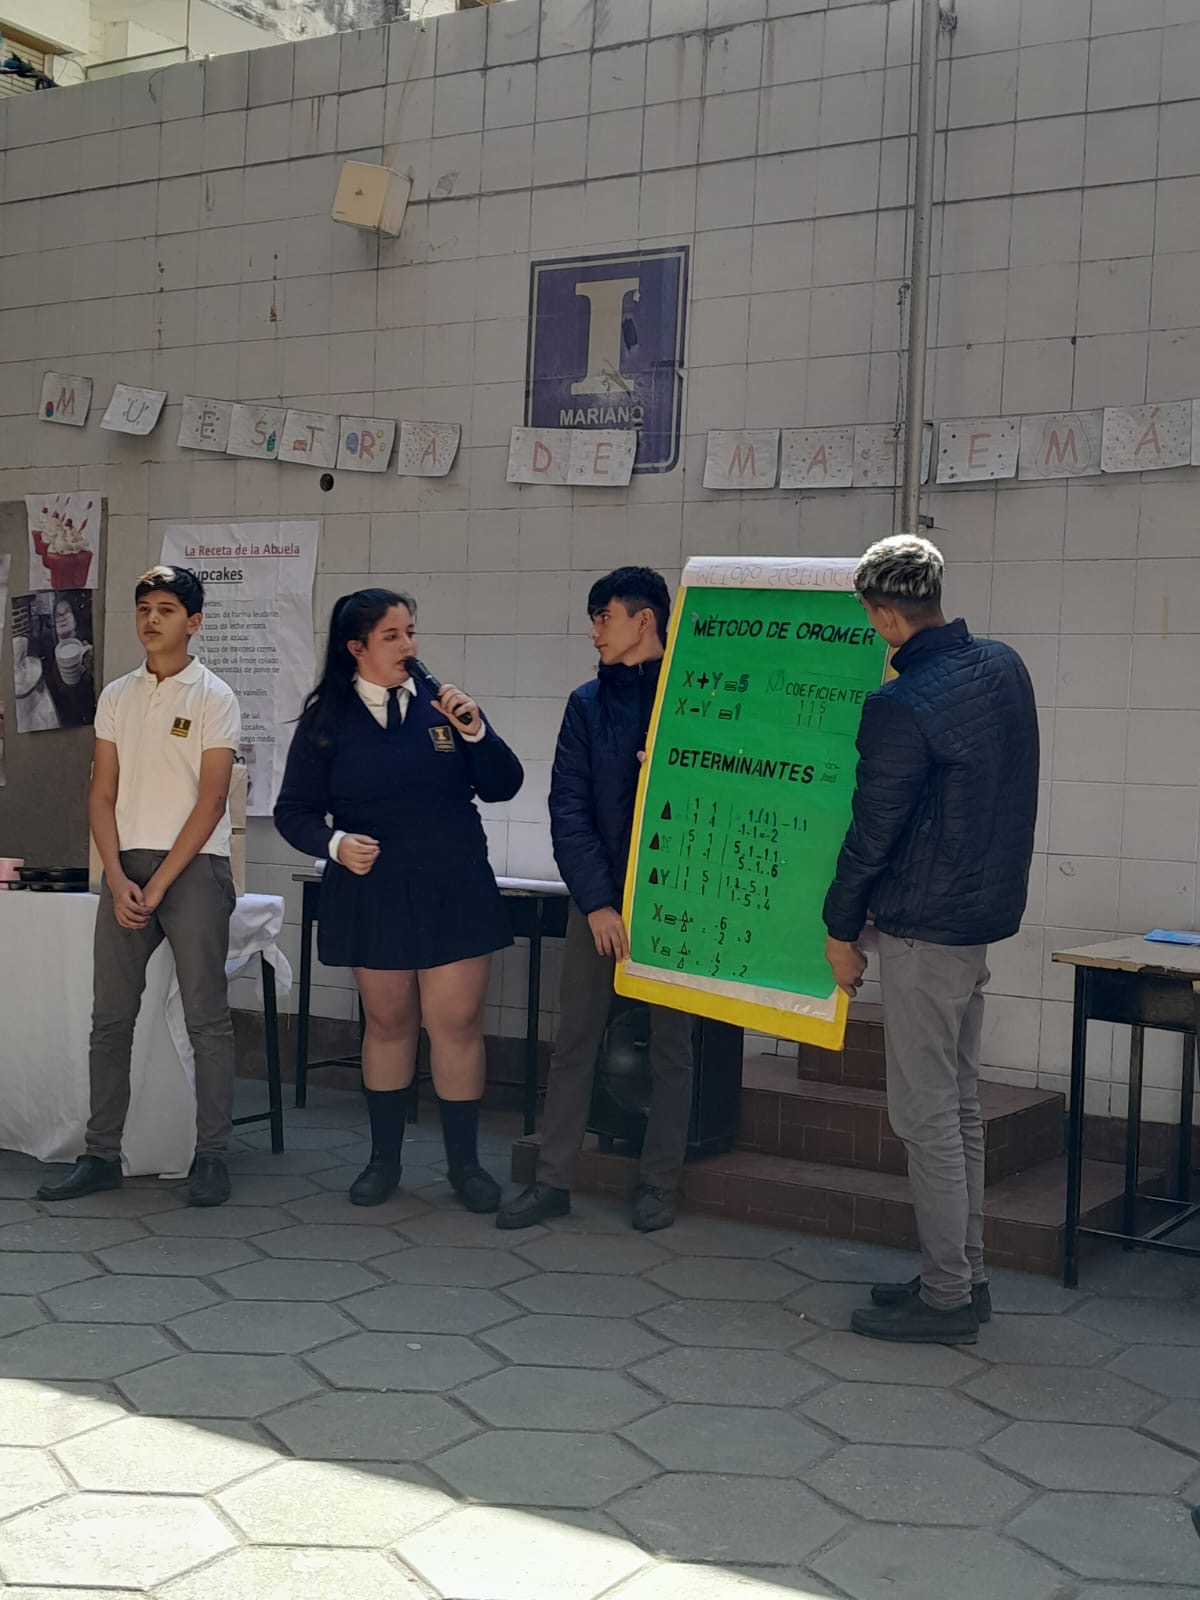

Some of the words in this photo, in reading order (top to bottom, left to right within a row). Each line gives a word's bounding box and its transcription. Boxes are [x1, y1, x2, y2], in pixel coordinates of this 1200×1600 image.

[559, 405, 644, 426] MARIANO
[184, 545, 196, 557] La
[199, 545, 232, 556] Receta
[235, 543, 248, 556] de
[250, 543, 260, 555] la
[263, 543, 300, 555] Abuela
[766, 621, 791, 640] DE
[668, 747, 815, 784] DETERMINANTES
